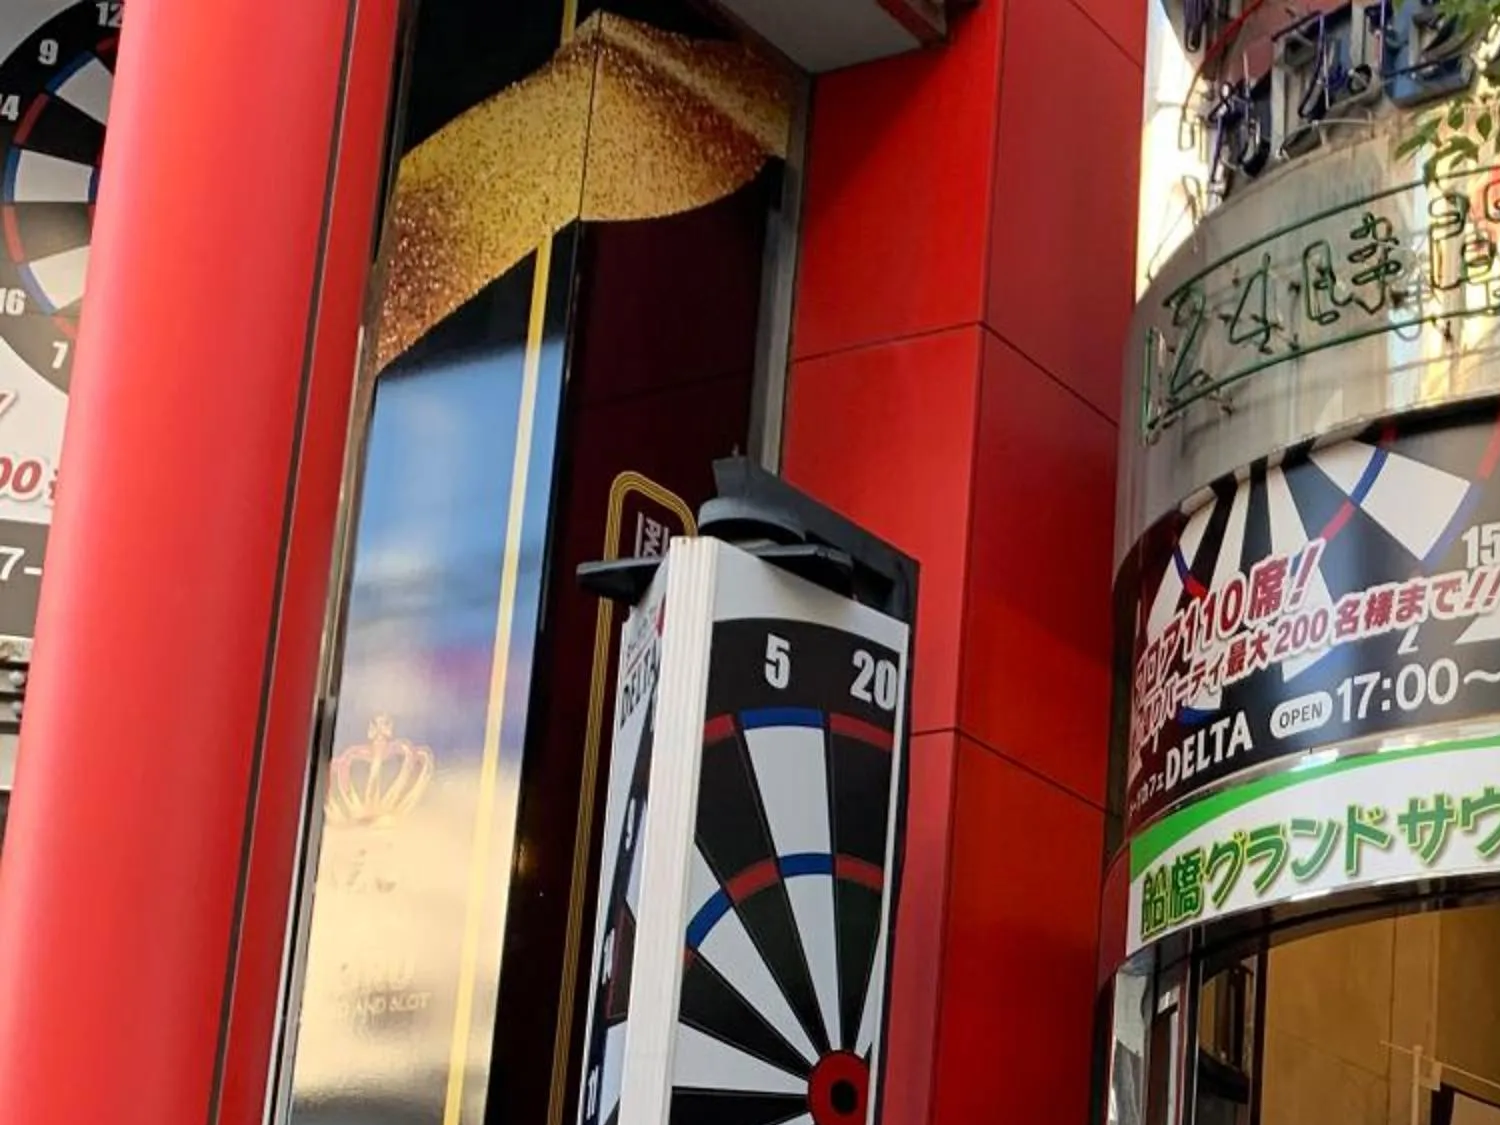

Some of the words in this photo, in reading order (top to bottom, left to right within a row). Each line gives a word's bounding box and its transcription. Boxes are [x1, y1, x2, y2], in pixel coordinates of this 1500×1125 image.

[38, 39, 58, 65] 9
[764, 633, 791, 690] 5
[850, 649, 898, 710] 20
[1279, 702, 1323, 729] OPEN
[1165, 710, 1253, 791] DELTA
